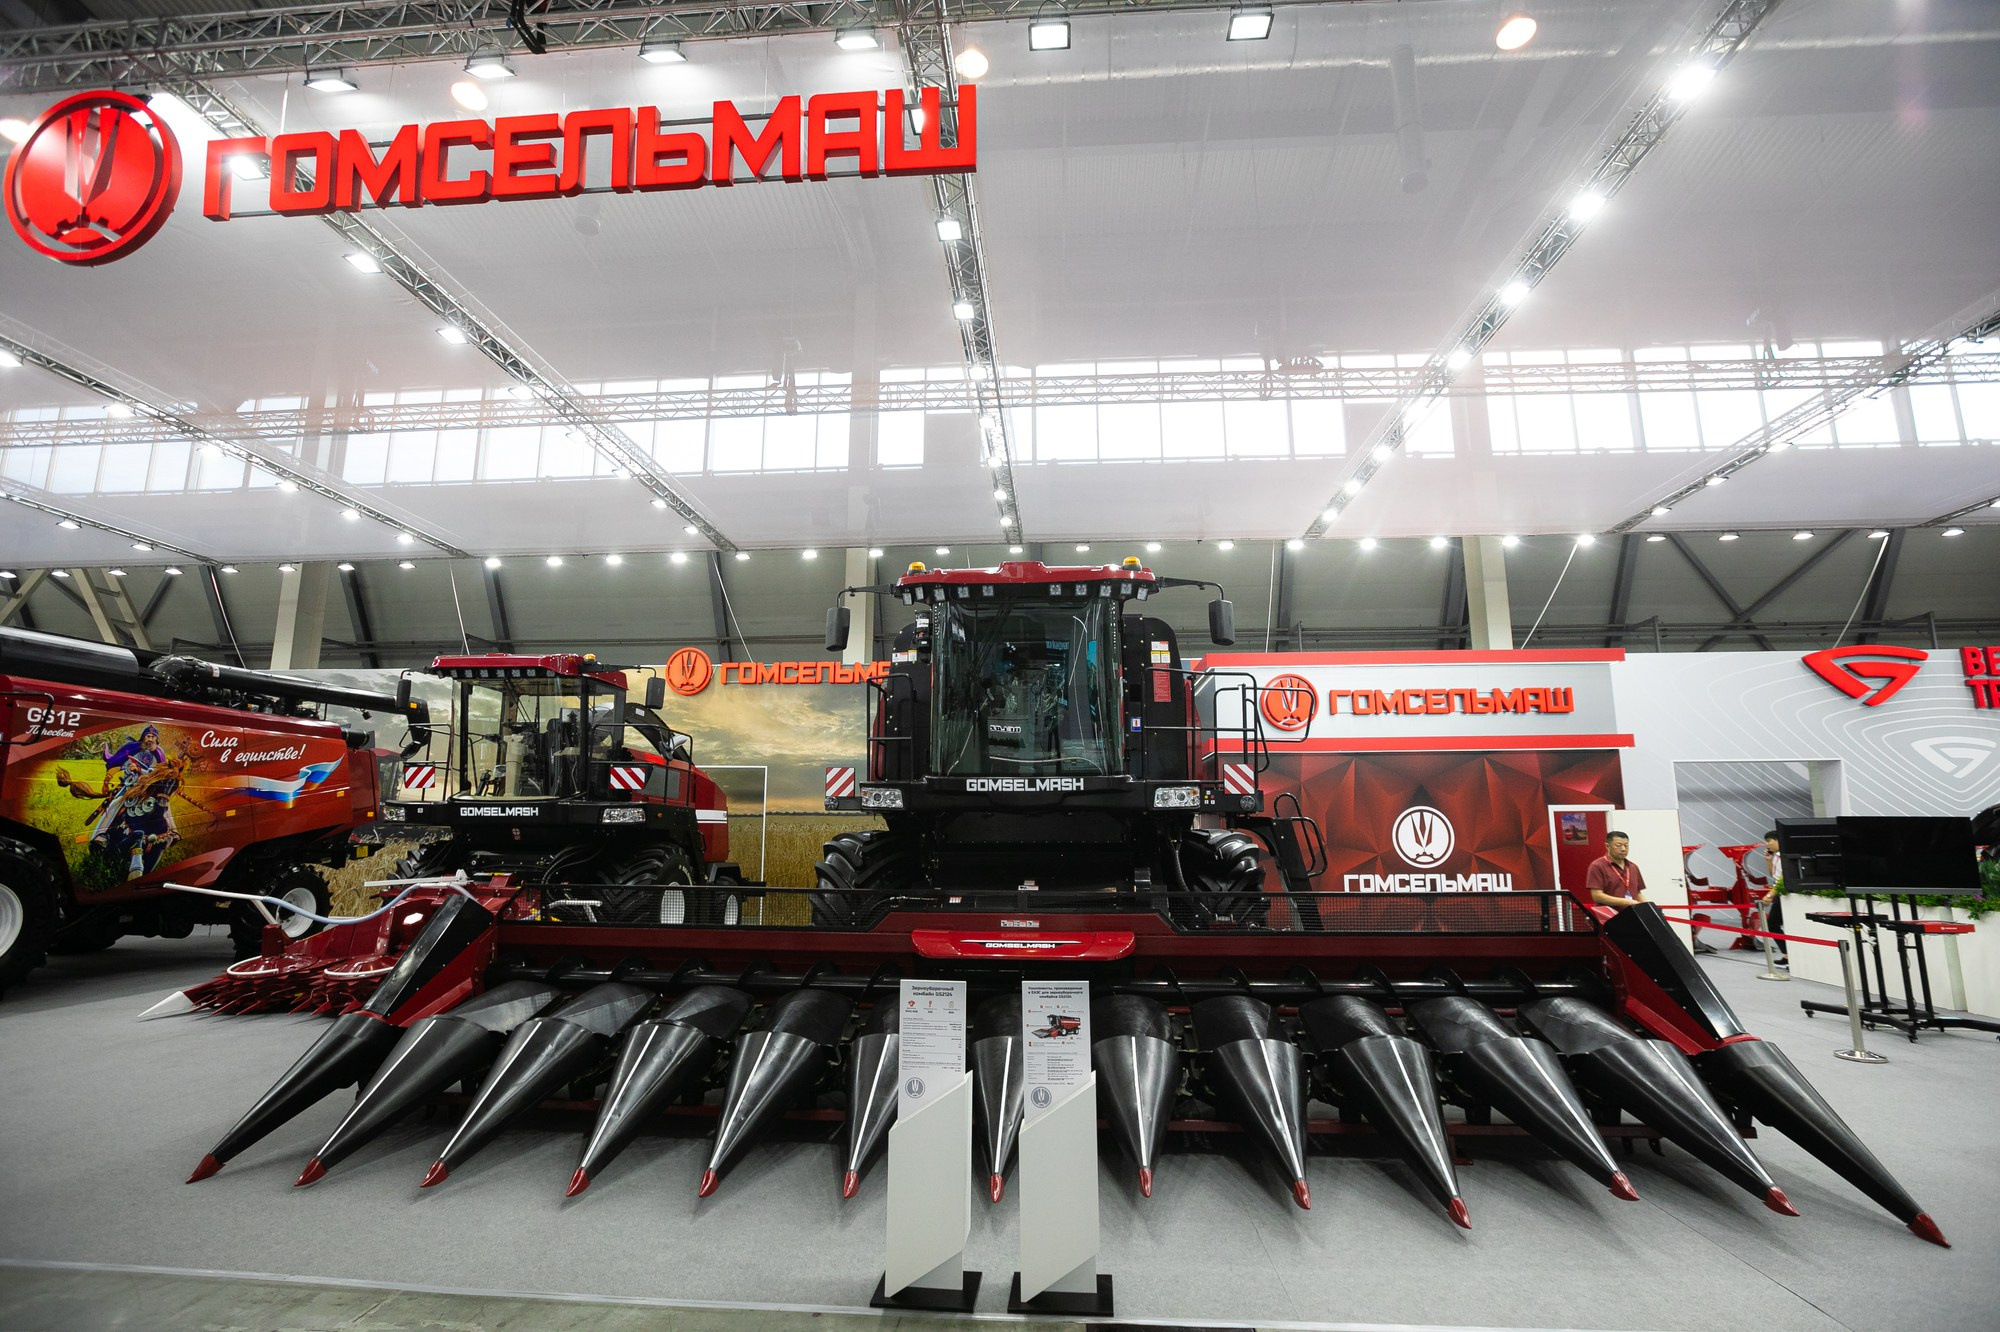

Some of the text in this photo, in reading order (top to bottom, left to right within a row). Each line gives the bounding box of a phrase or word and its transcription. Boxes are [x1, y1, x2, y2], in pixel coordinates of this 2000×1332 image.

[203, 84, 977, 222] ГОМСЕЛЬМАШ
[1329, 687, 1574, 715] ГОМСЕЛЬМАШ
[27, 707, 81, 727] GS12
[25, 725, 76, 738] Пресвет
[200, 730, 239, 748] Сила
[220, 744, 306, 767] в единстве!
[966, 778, 1084, 791] GOMSELMASH
[460, 807, 539, 816] GOMSELMASH
[1343, 873, 1513, 892] ГОМСЕЛЬМАШ
